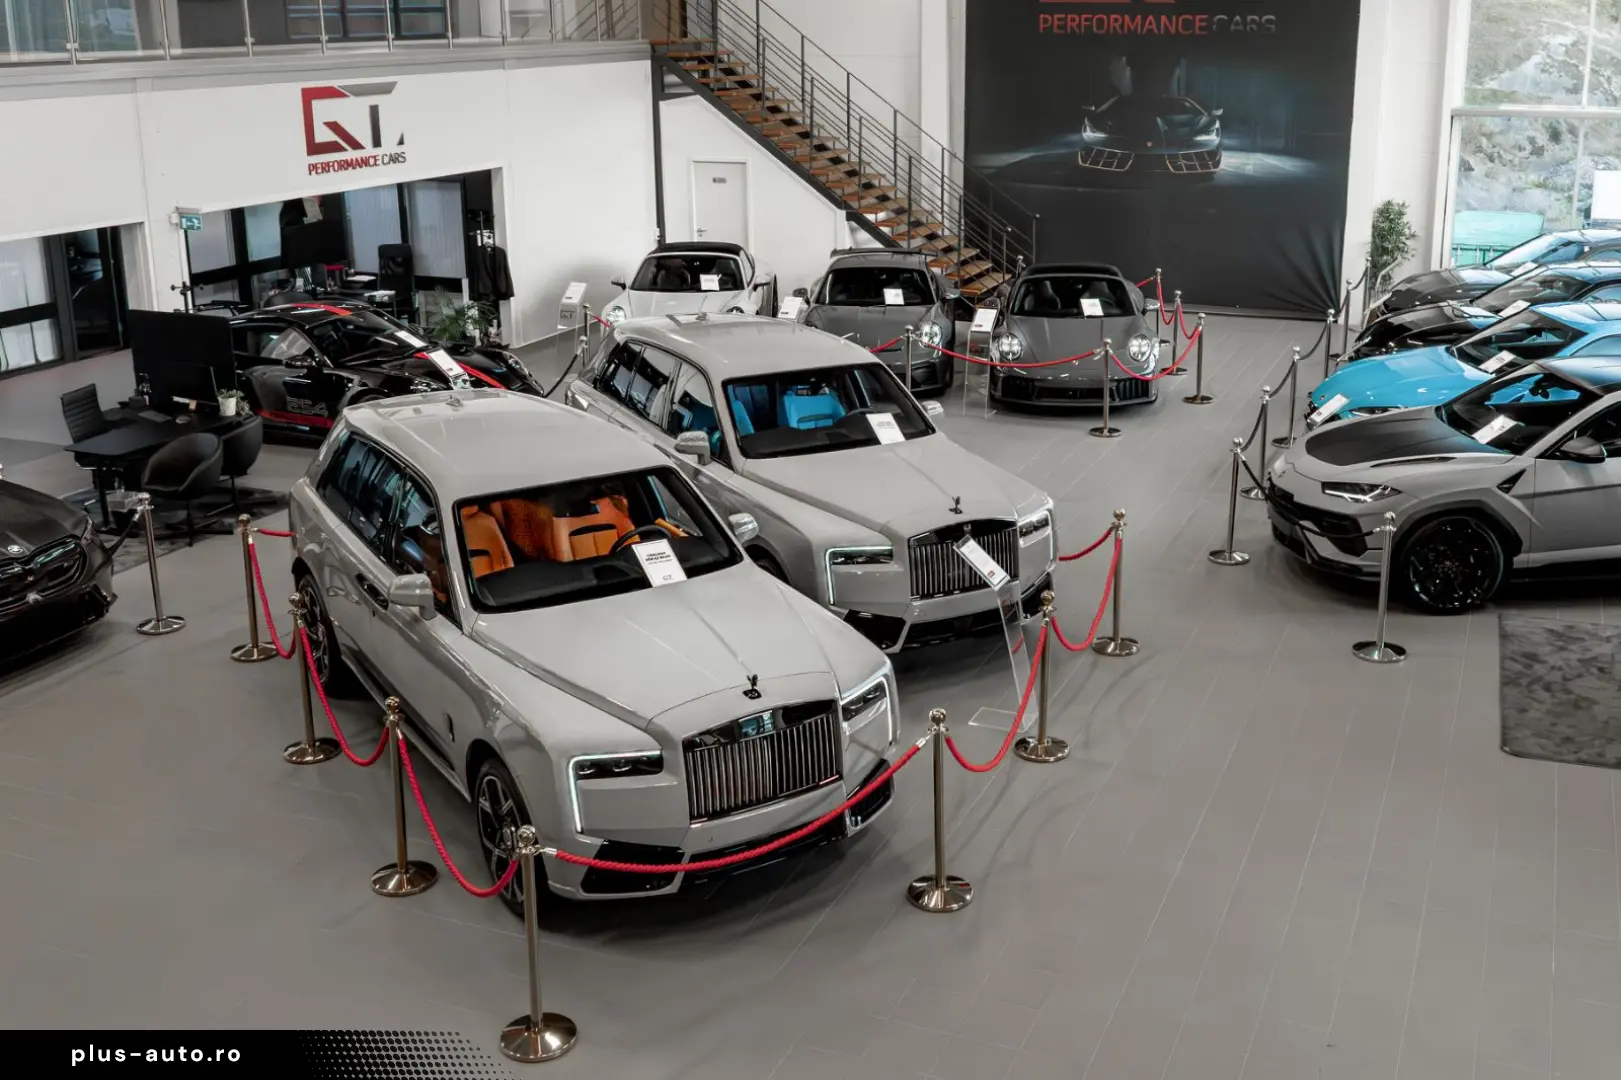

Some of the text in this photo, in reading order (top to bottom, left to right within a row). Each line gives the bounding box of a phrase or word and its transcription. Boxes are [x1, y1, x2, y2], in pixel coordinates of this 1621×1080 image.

[1038, 13, 1277, 35] PERFORMANCE CARS
[308, 152, 407, 176] PERFORMANCE CARS
